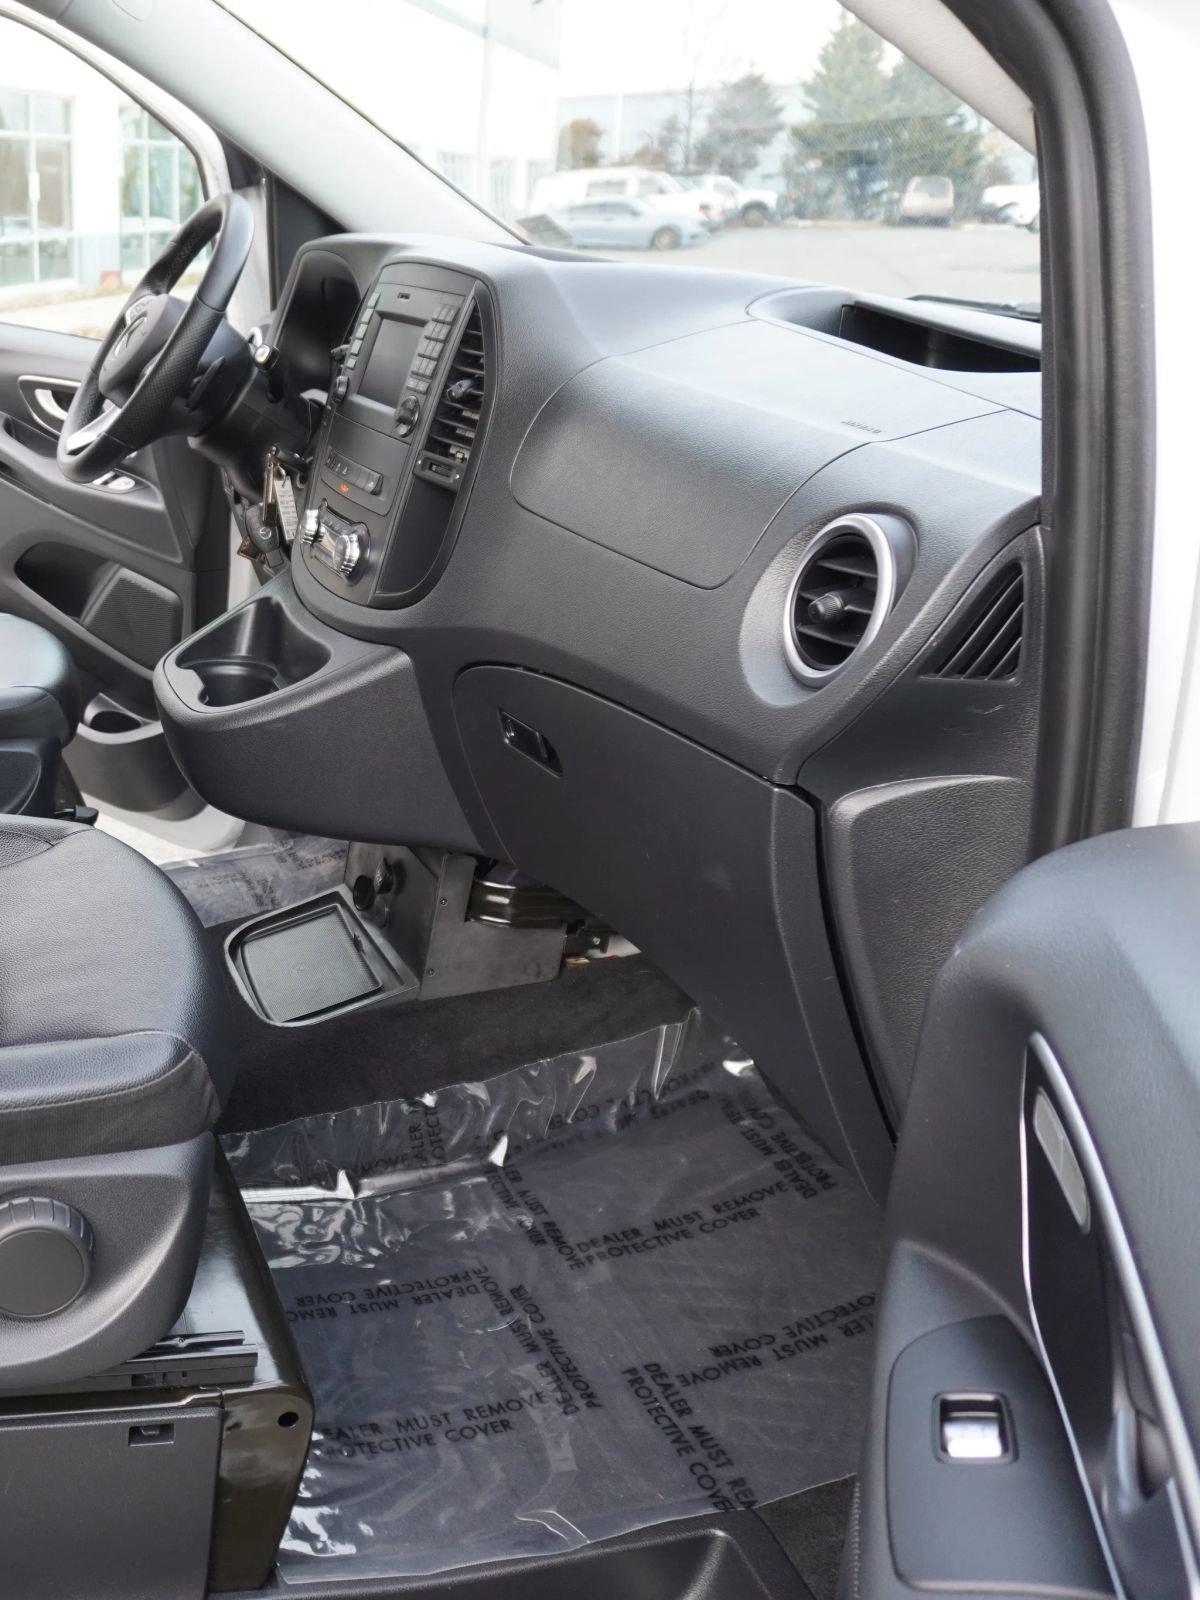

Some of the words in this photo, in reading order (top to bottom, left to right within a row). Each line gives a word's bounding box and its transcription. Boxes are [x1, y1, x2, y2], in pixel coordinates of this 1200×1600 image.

[408, 1120, 428, 1163] ALER
[576, 1227, 643, 1254] DEALER
[652, 1210, 705, 1233] MUST
[712, 1181, 790, 1215] REMOVE
[585, 1229, 695, 1266] PROTECTIVE
[699, 1207, 761, 1235] COVER
[542, 1220, 587, 1271] REMOVE
[296, 1289, 357, 1308] COVER
[363, 1271, 474, 1299] PROTECTIVE
[414, 1283, 482, 1306] DEALER
[472, 1265, 516, 1317] REMOVE
[509, 1283, 546, 1325] COVER
[350, 1299, 401, 1316] MUST
[782, 1292, 878, 1340] OTECTIVE
[708, 1333, 777, 1359] COVER
[772, 1332, 830, 1362] MUST
[535, 1359, 581, 1417] DEALER
[537, 1328, 603, 1410] PROTECTIVE
[674, 1353, 764, 1388] REMOVE
[395, 1412, 452, 1434] MUST
[463, 1390, 549, 1423] REMOVE
[445, 1419, 515, 1443] COVER
[621, 1366, 697, 1457] PROTECTIVE
[643, 1361, 694, 1420] DEALER
[688, 1424, 735, 1471] MUST
